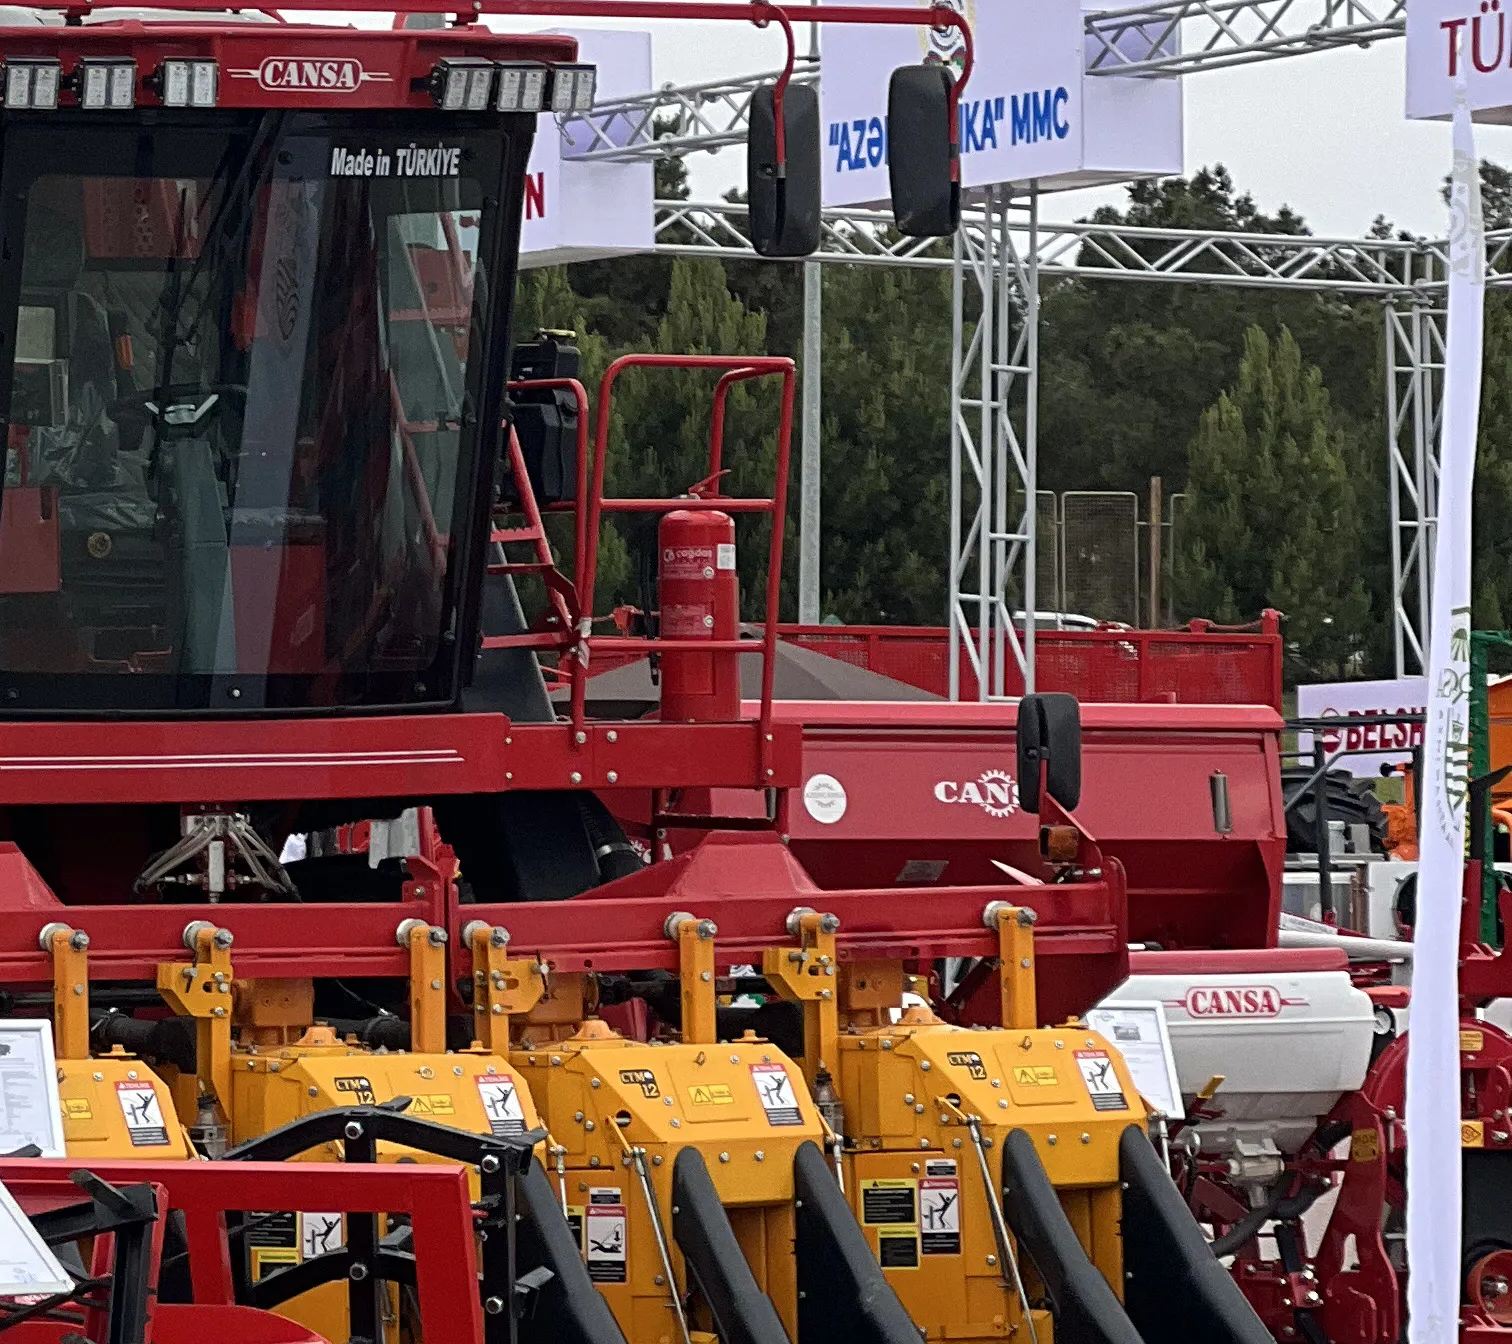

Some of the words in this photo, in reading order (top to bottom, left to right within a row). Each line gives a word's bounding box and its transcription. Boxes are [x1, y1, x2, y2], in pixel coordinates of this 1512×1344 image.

[264, 61, 355, 87] CANSA
[1011, 86, 1070, 146] MMC
[331, 147, 374, 176] Made
[375, 148, 390, 176] in
[396, 142, 461, 176] TÜRKİYE
[1346, 706, 1426, 750] BELSH
[934, 781, 1020, 805] CAN
[1191, 990, 1277, 1014] CANSA
[970, 1065, 986, 1078] 12
[358, 1091, 375, 1105] 12
[642, 1084, 659, 1097] 12
